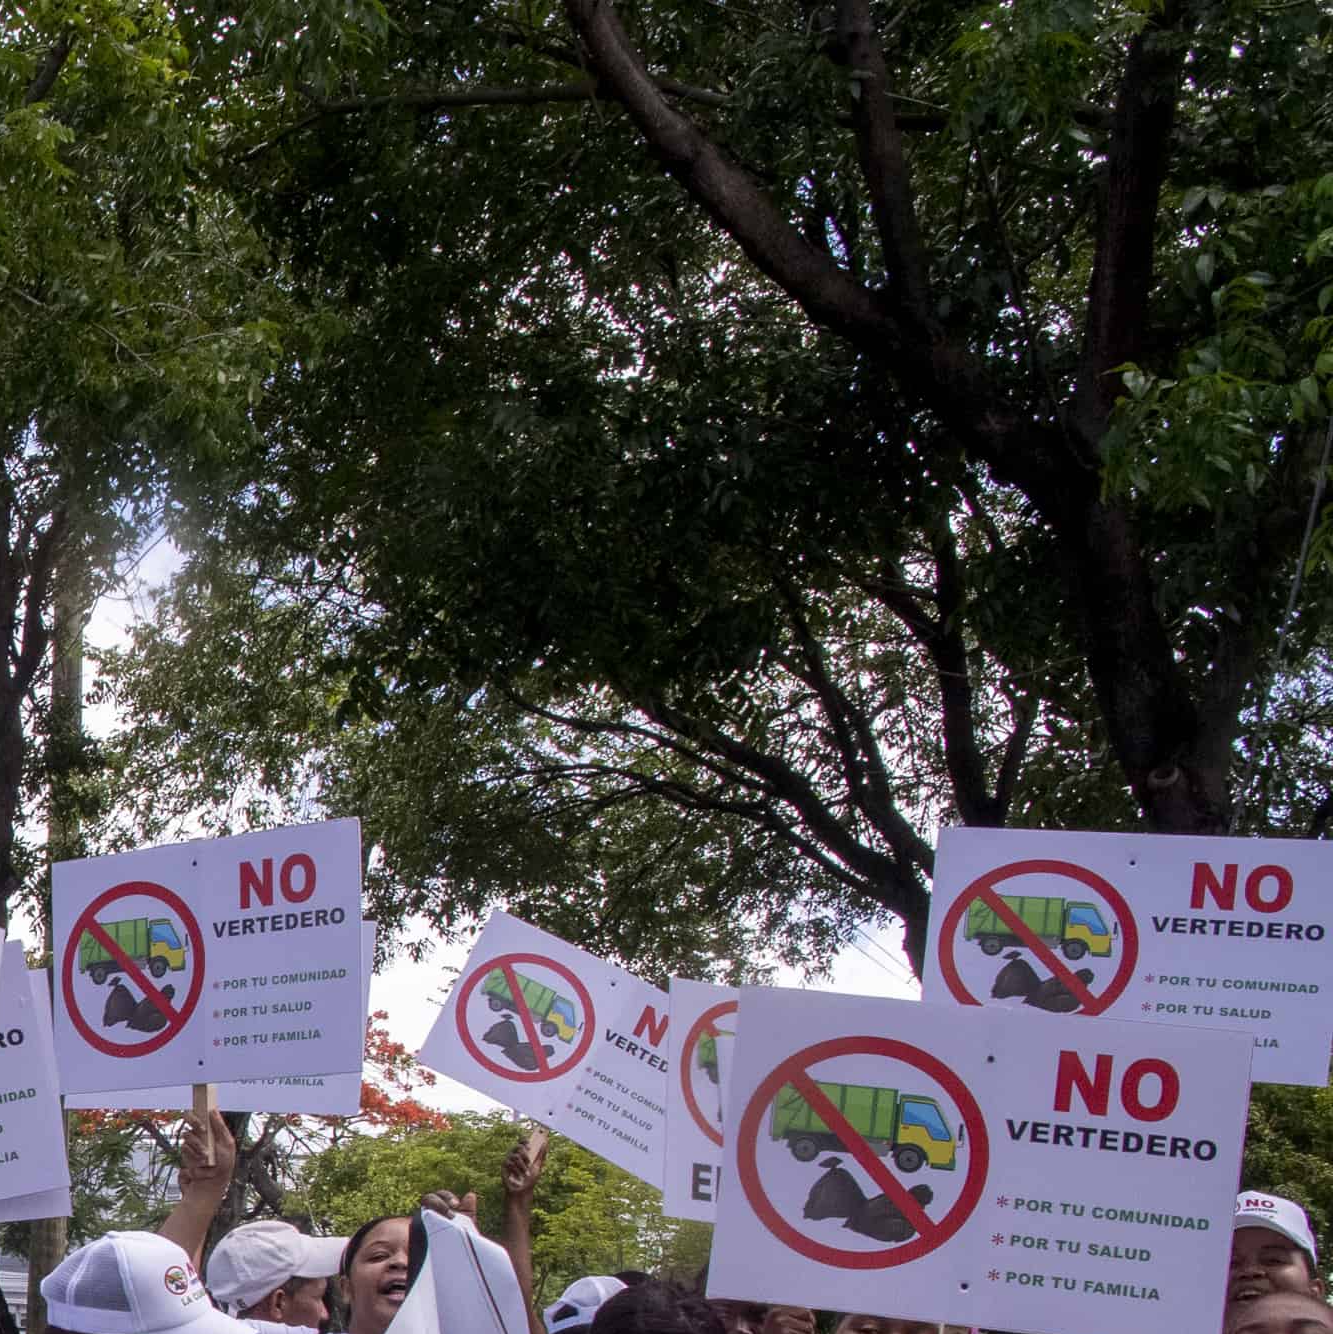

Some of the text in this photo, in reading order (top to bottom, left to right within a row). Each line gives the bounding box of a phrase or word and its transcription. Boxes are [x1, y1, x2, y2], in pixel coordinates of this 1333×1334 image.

[239, 853, 316, 910] NO
[1189, 862, 1294, 913] NO
[213, 907, 345, 938] VERTEDERO
[1151, 916, 1325, 941] VERTEDERO
[223, 968, 346, 990] POR TU COMUNIDAD
[1158, 975, 1319, 994] POR TU COMUNIDAD
[223, 1001, 312, 1019] POR TU SALUD
[633, 1004, 669, 1048] N
[1155, 1003, 1272, 1019] POR TU SALUD
[223, 1029, 321, 1047] POR TU FAMILIA
[605, 1029, 668, 1073] VERTED
[593, 1071, 665, 1115] POR TU COMUN
[1053, 1050, 1180, 1122] NO
[583, 1088, 653, 1131] POR TU SALUD
[574, 1107, 649, 1153] POR TU FAMILIA
[1006, 1119, 1217, 1161] VERTEDERO
[1013, 1198, 1210, 1231] POR TU COMUNIDAD
[1245, 1199, 1275, 1208] NO
[1009, 1234, 1151, 1262] POR TU SALUD
[1005, 1271, 1160, 1301] POR TU FAMILIA
